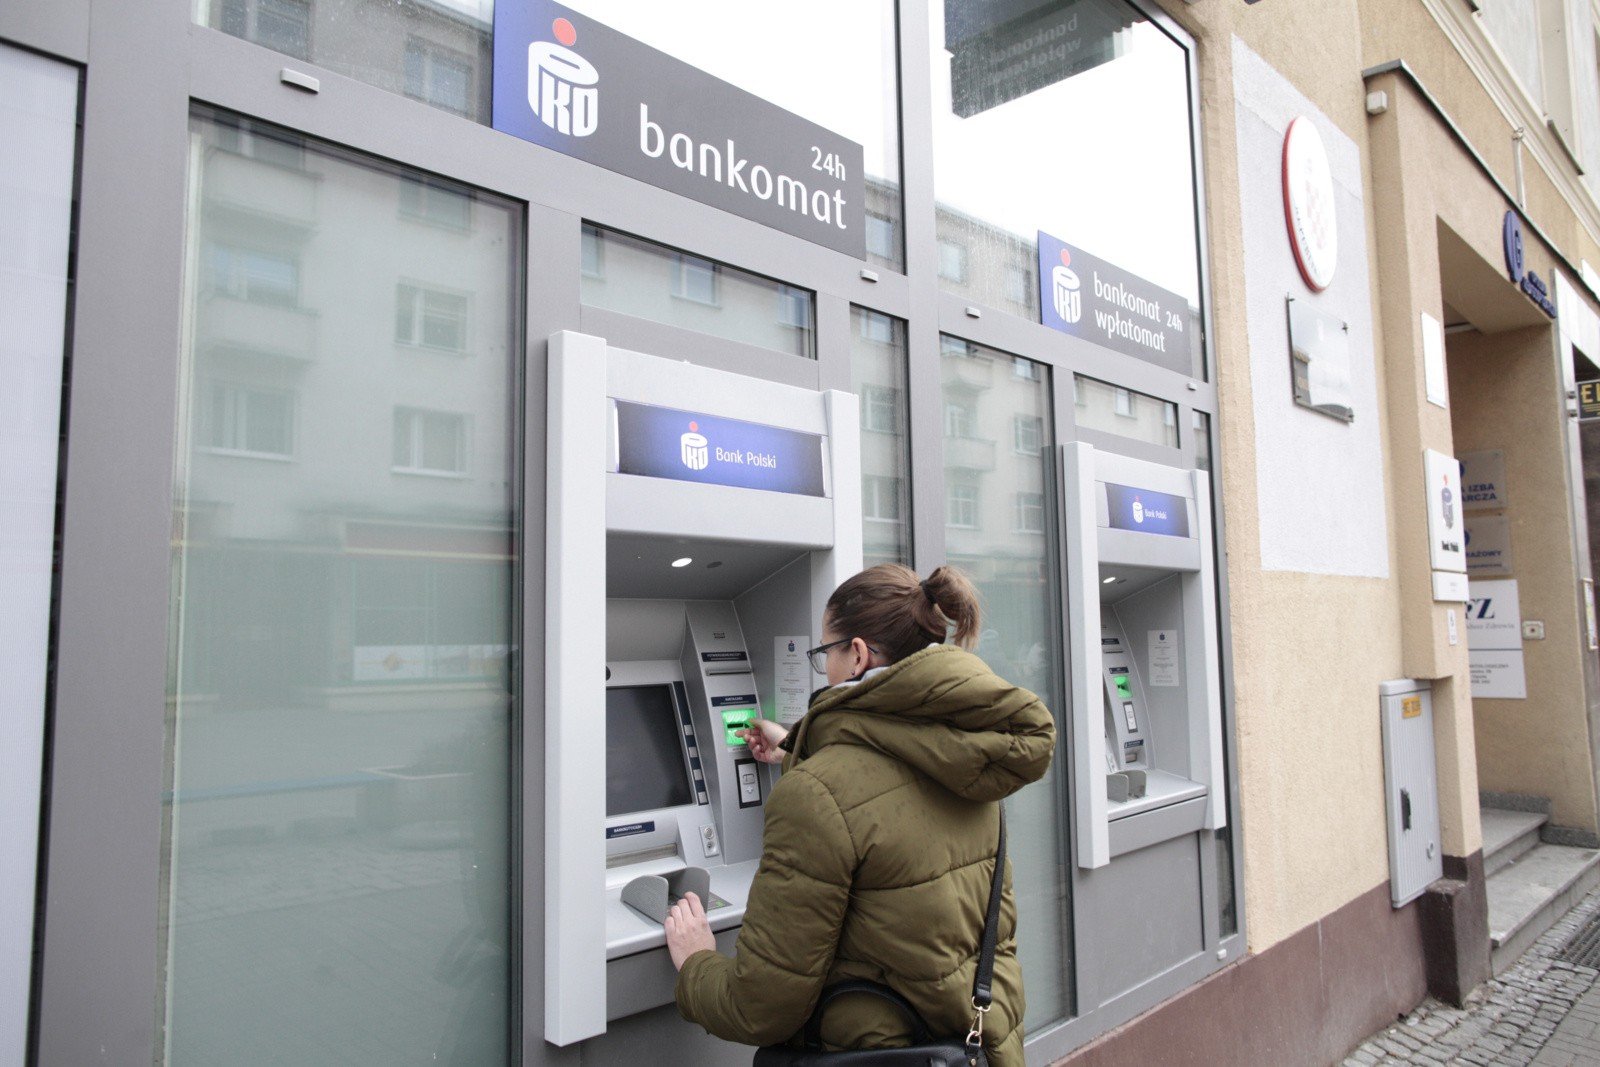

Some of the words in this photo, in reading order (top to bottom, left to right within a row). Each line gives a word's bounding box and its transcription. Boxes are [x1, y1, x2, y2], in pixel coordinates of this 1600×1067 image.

[528, 40, 599, 137] PKO
[640, 102, 847, 229] bankomat
[811, 146, 846, 181] 24h
[1052, 265, 1081, 324] PKO
[1093, 271, 1161, 322] bankomat
[1165, 310, 1183, 332] 24h
[1094, 309, 1166, 352] wpłatomat
[716, 447, 743, 464] Bank
[747, 451, 776, 469] Polski
[1468, 483, 1495, 492] IZBA
